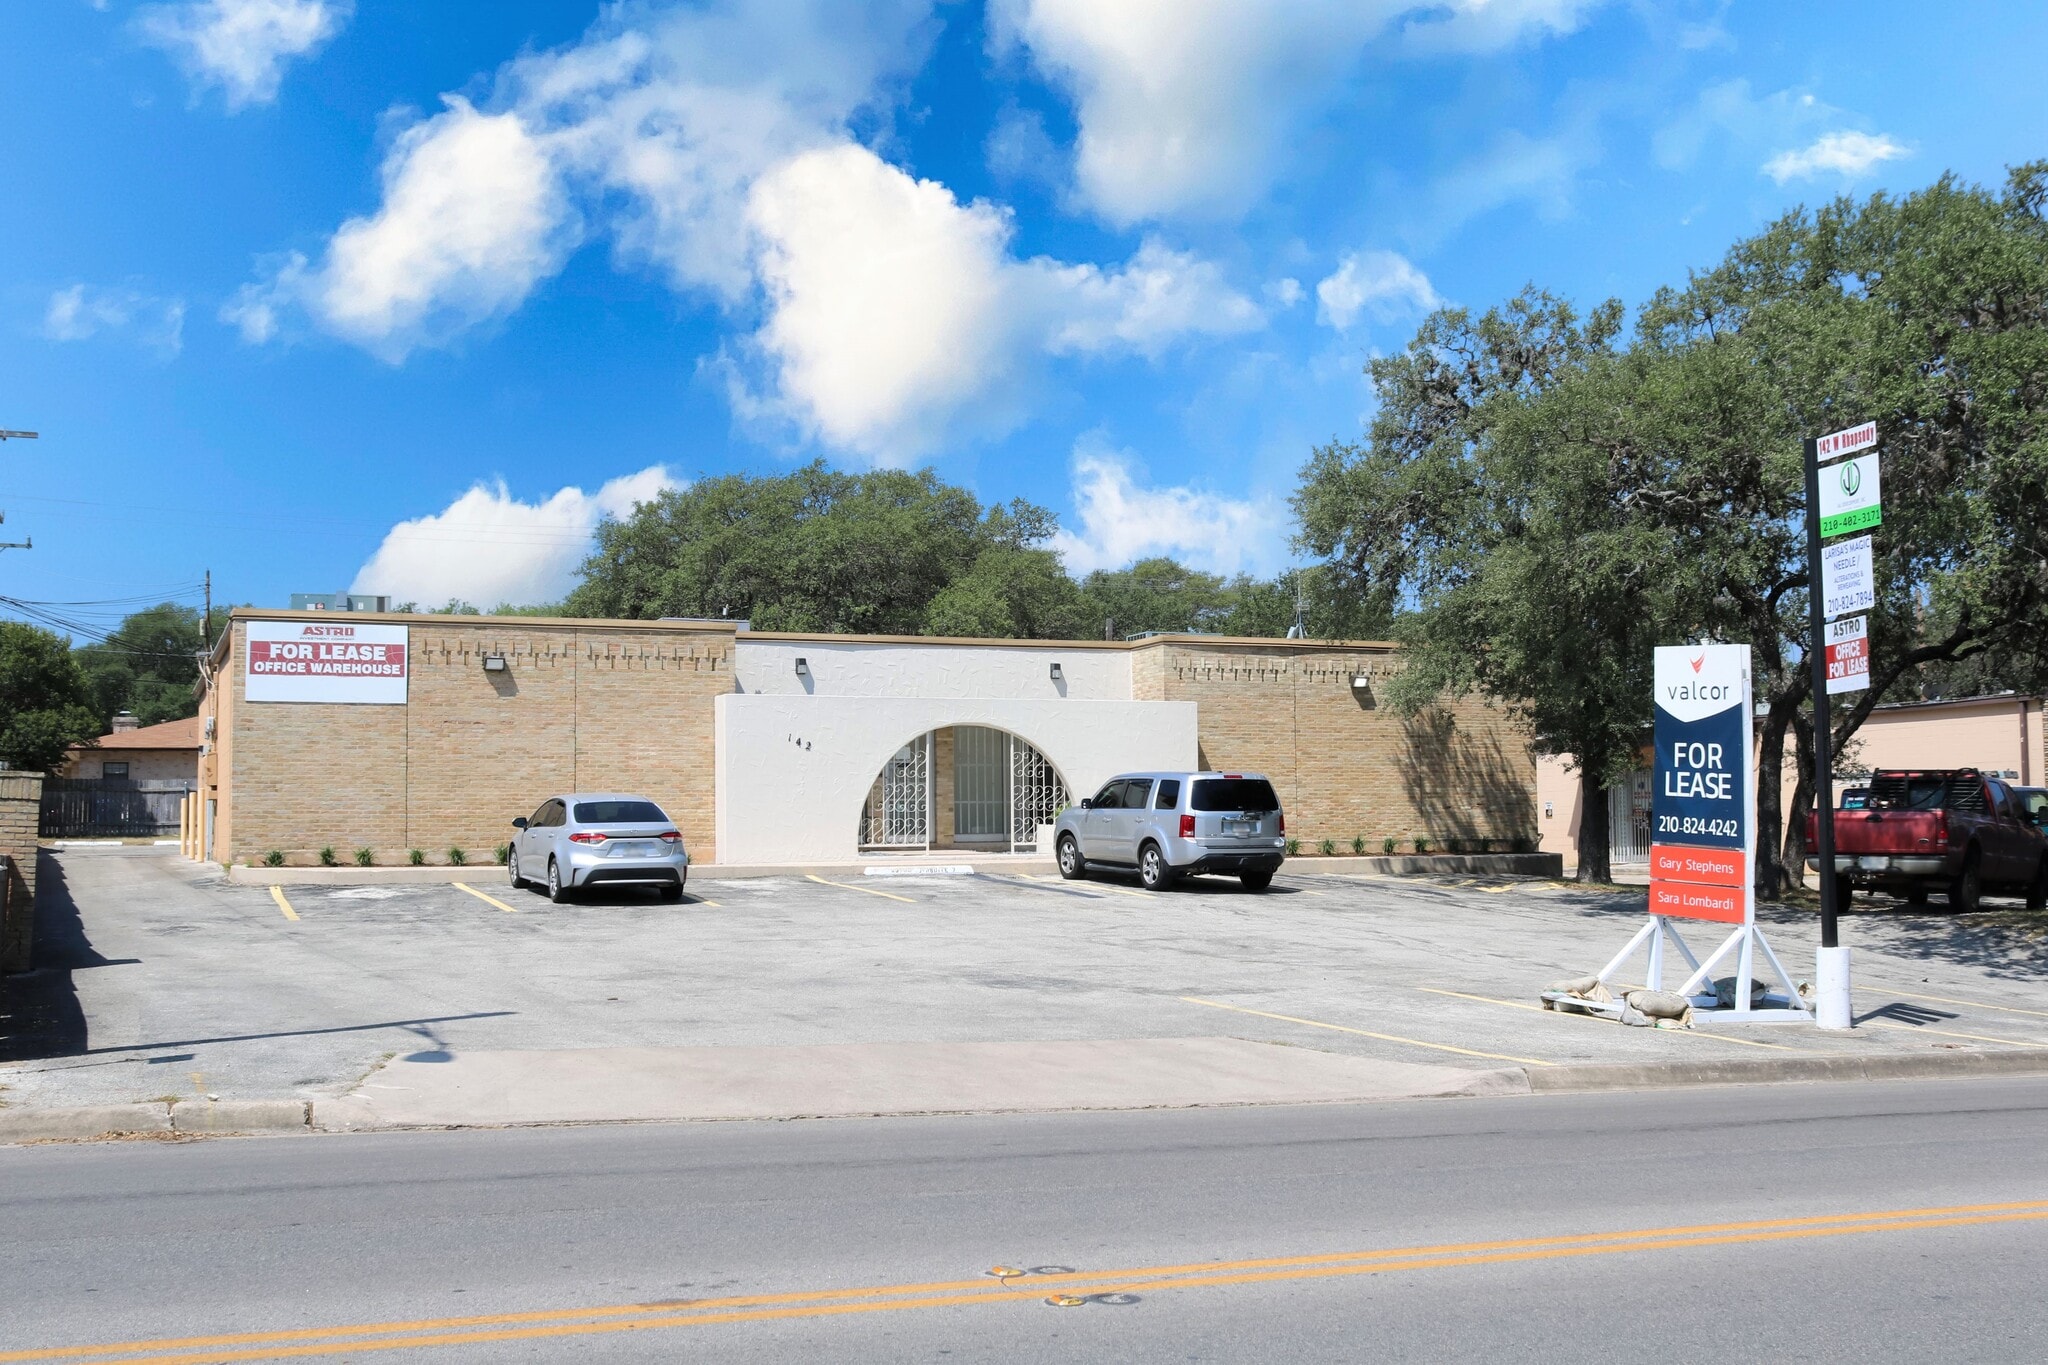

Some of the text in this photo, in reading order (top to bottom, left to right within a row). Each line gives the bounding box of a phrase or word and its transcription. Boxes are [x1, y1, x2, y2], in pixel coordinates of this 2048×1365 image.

[1818, 425, 1874, 455] 142 W Rhapsody
[1823, 509, 1880, 532] 210-402-3171
[1824, 538, 1871, 560] LARISA'S MAGIC
[1833, 556, 1856, 571] NEEDLE
[1833, 571, 1860, 583] ALTERATIONS
[1828, 590, 1873, 613] 210-824-7894
[303, 626, 354, 636] ASTRO
[1833, 618, 1860, 638] ASTRO
[269, 643, 387, 661] FOR LEASE
[1835, 641, 1861, 661] OFFICE
[254, 661, 401, 675] OFFICE WAREHOUSE
[1829, 656, 1869, 679] FOR LEASE
[1667, 681, 1729, 701] valcor
[788, 733, 812, 752] 142
[1674, 742, 1723, 769] FOR
[1665, 771, 1732, 800] LEASE
[1658, 815, 1738, 837] 210-824-4242
[1659, 856, 1734, 876] Gary Stephens
[1657, 891, 1734, 910] Sara Lombardi
